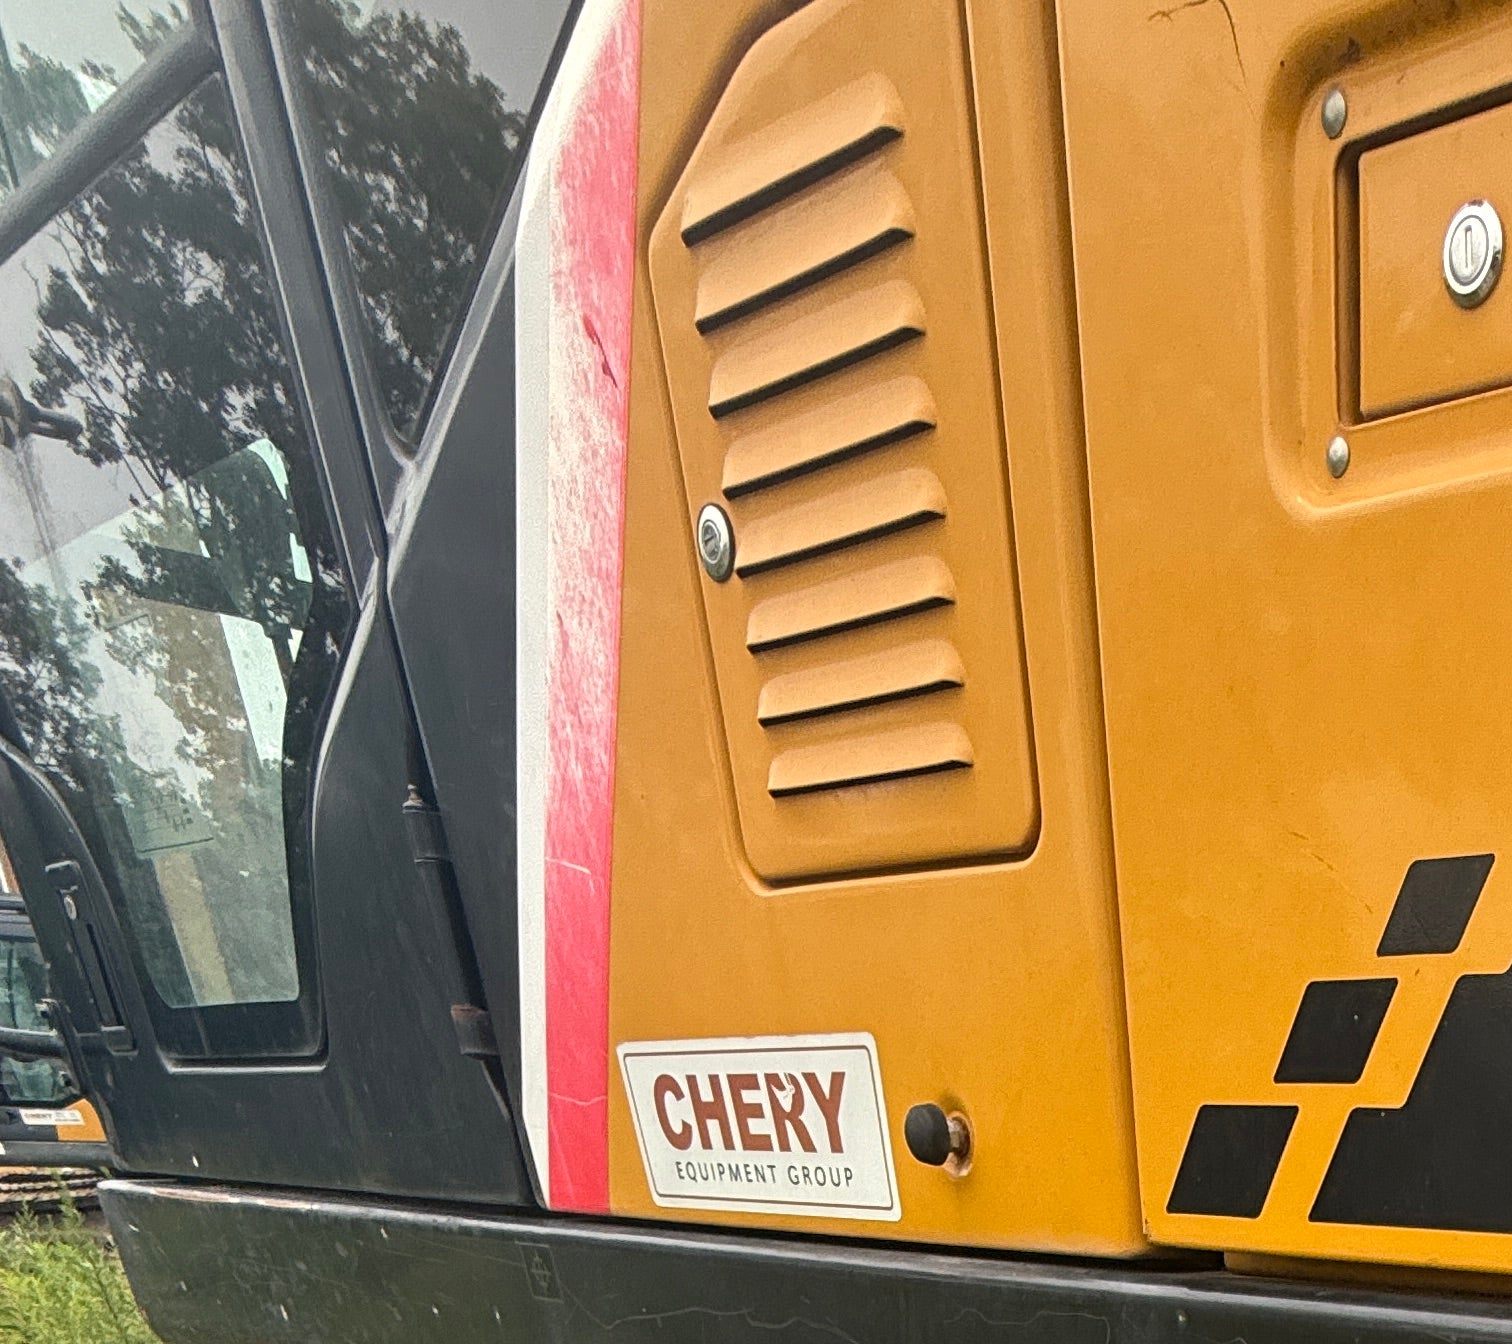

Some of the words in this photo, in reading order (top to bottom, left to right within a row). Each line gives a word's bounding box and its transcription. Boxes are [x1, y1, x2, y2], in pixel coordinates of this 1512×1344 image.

[653, 1071, 846, 1153] CHERY
[675, 1161, 776, 1184] EQUIPMENT
[787, 1165, 854, 1188] GROUP
